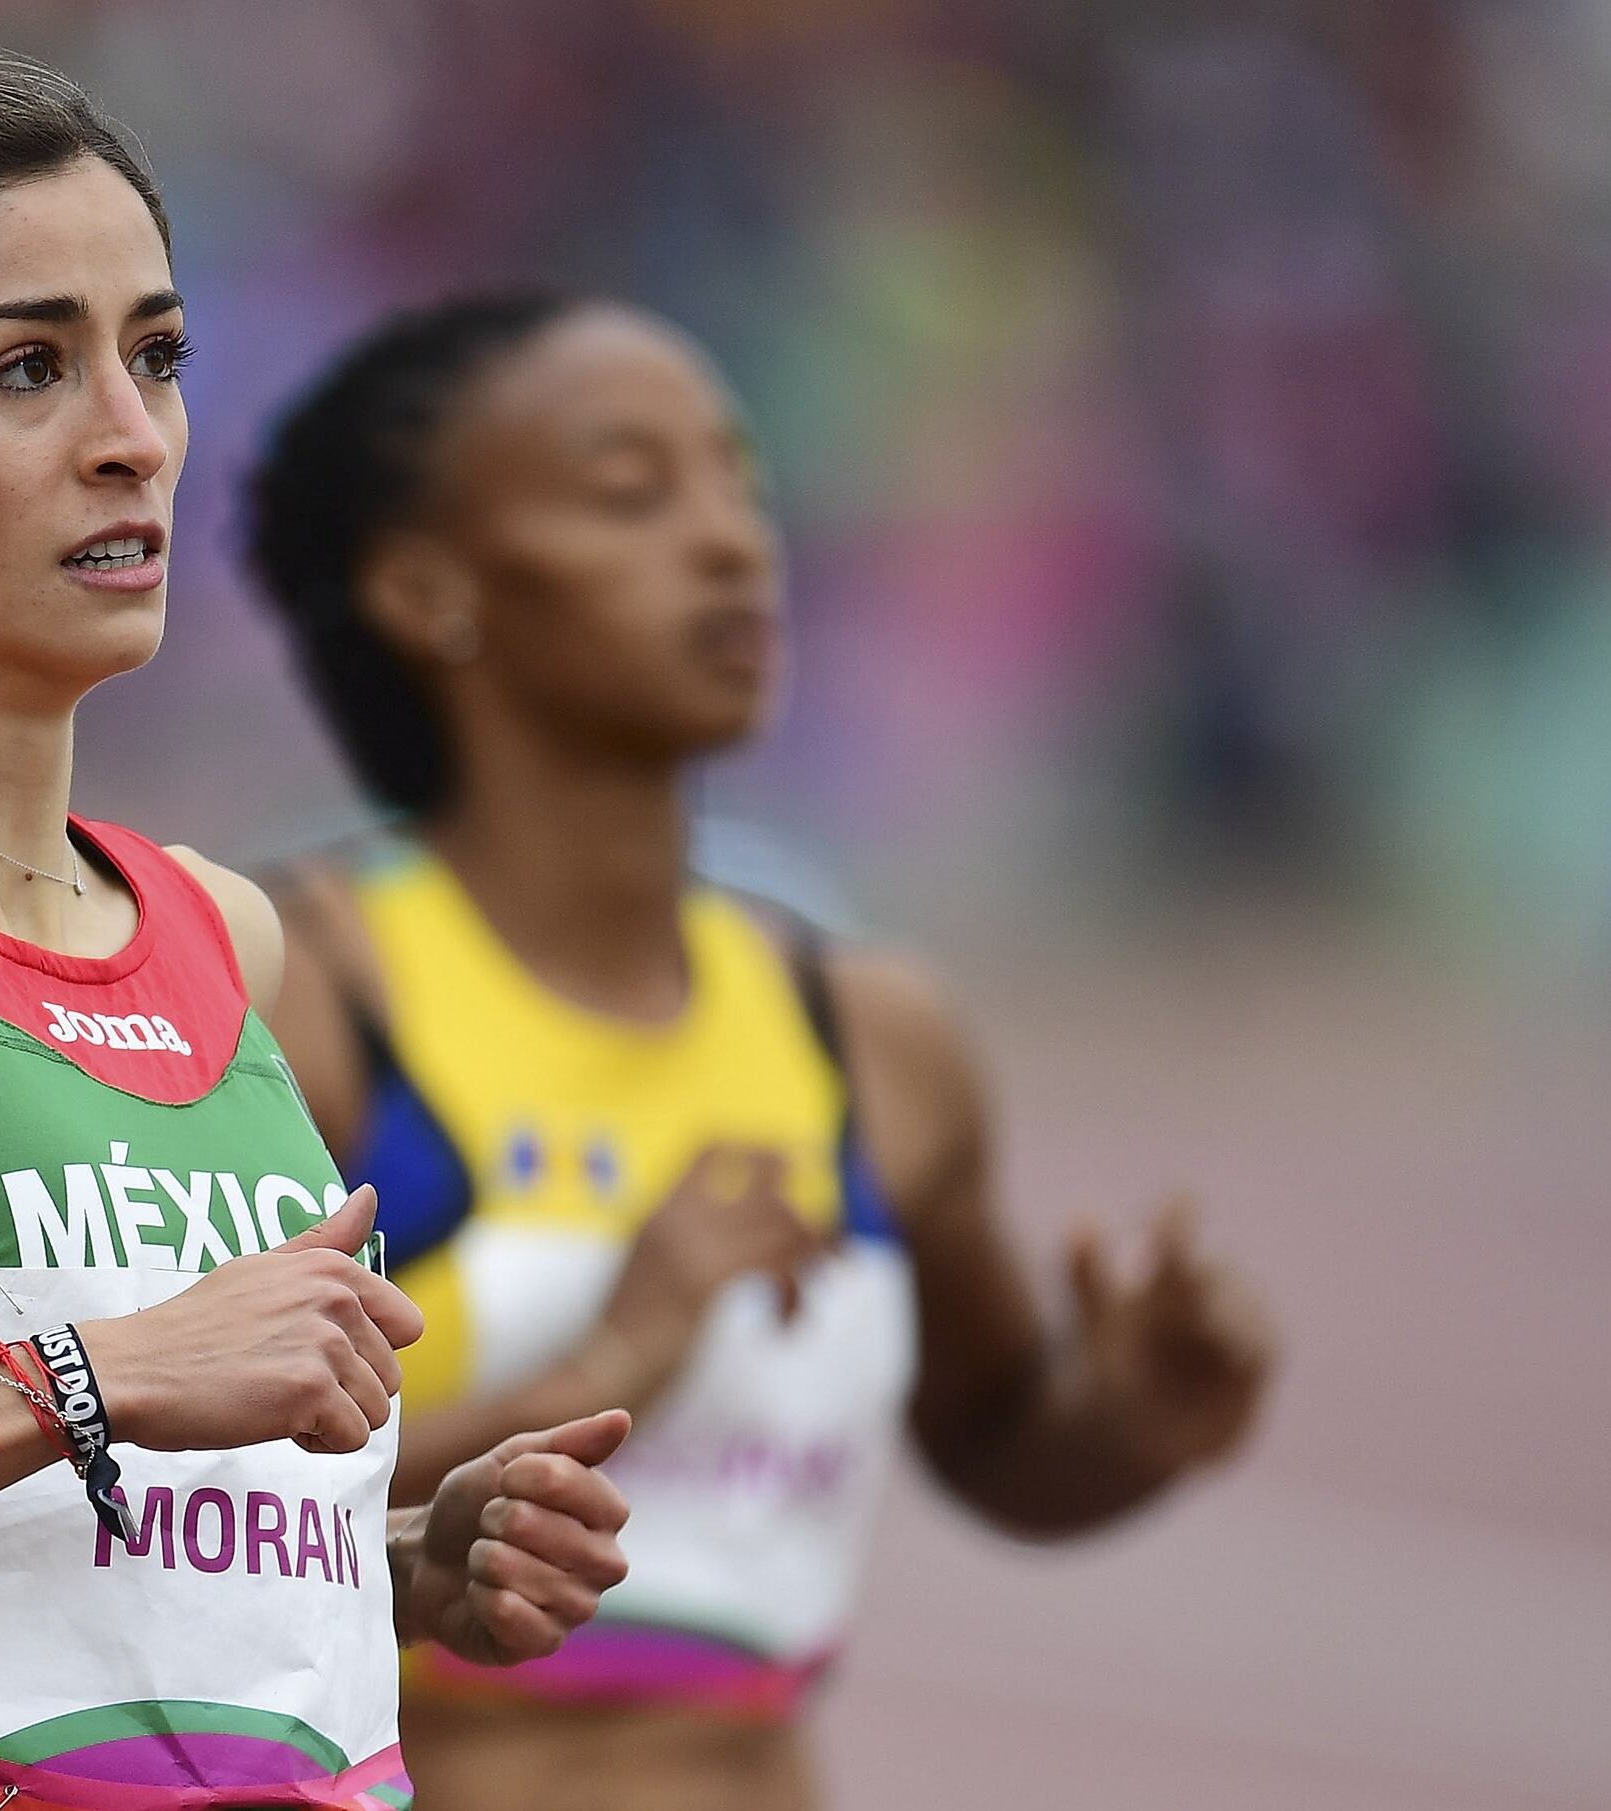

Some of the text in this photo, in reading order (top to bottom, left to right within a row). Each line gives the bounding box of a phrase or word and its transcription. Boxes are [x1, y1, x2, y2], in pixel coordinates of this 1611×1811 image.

[41, 1001, 192, 1056] Joma
[1, 1141, 349, 1272] MÉXIC
[38, 1324, 85, 1371] UST
[56, 1368, 97, 1422] DO
[93, 1486, 360, 1589] MORAN
